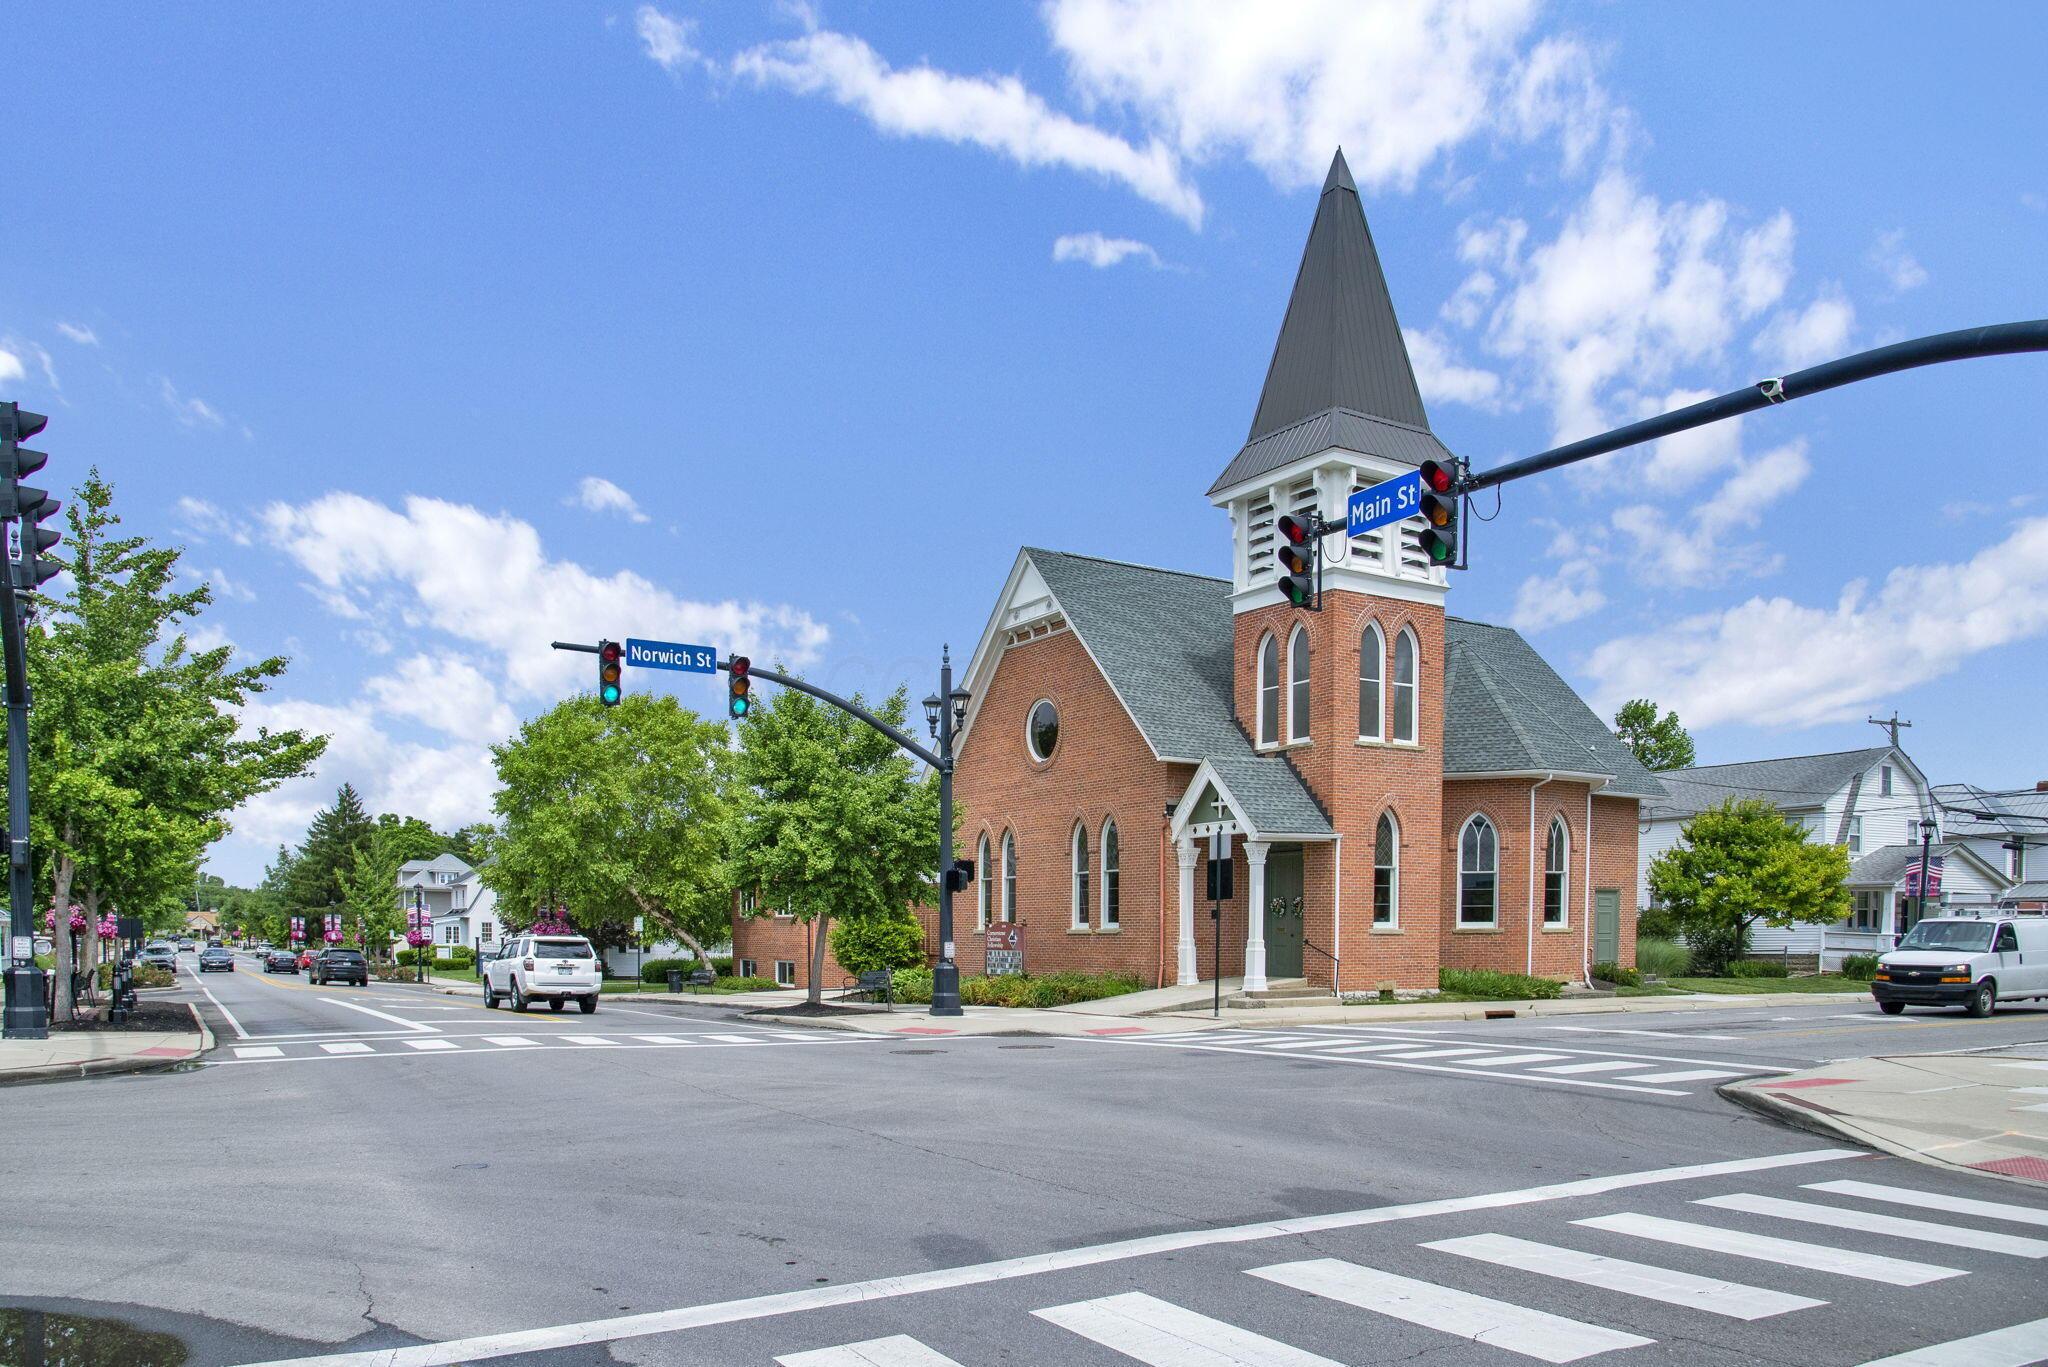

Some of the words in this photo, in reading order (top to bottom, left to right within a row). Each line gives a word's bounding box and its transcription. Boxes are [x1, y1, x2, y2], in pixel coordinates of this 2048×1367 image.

[1352, 495, 1391, 526] Main
[1397, 484, 1415, 509] St
[631, 645, 691, 666] Norwich
[696, 652, 711, 667] St
